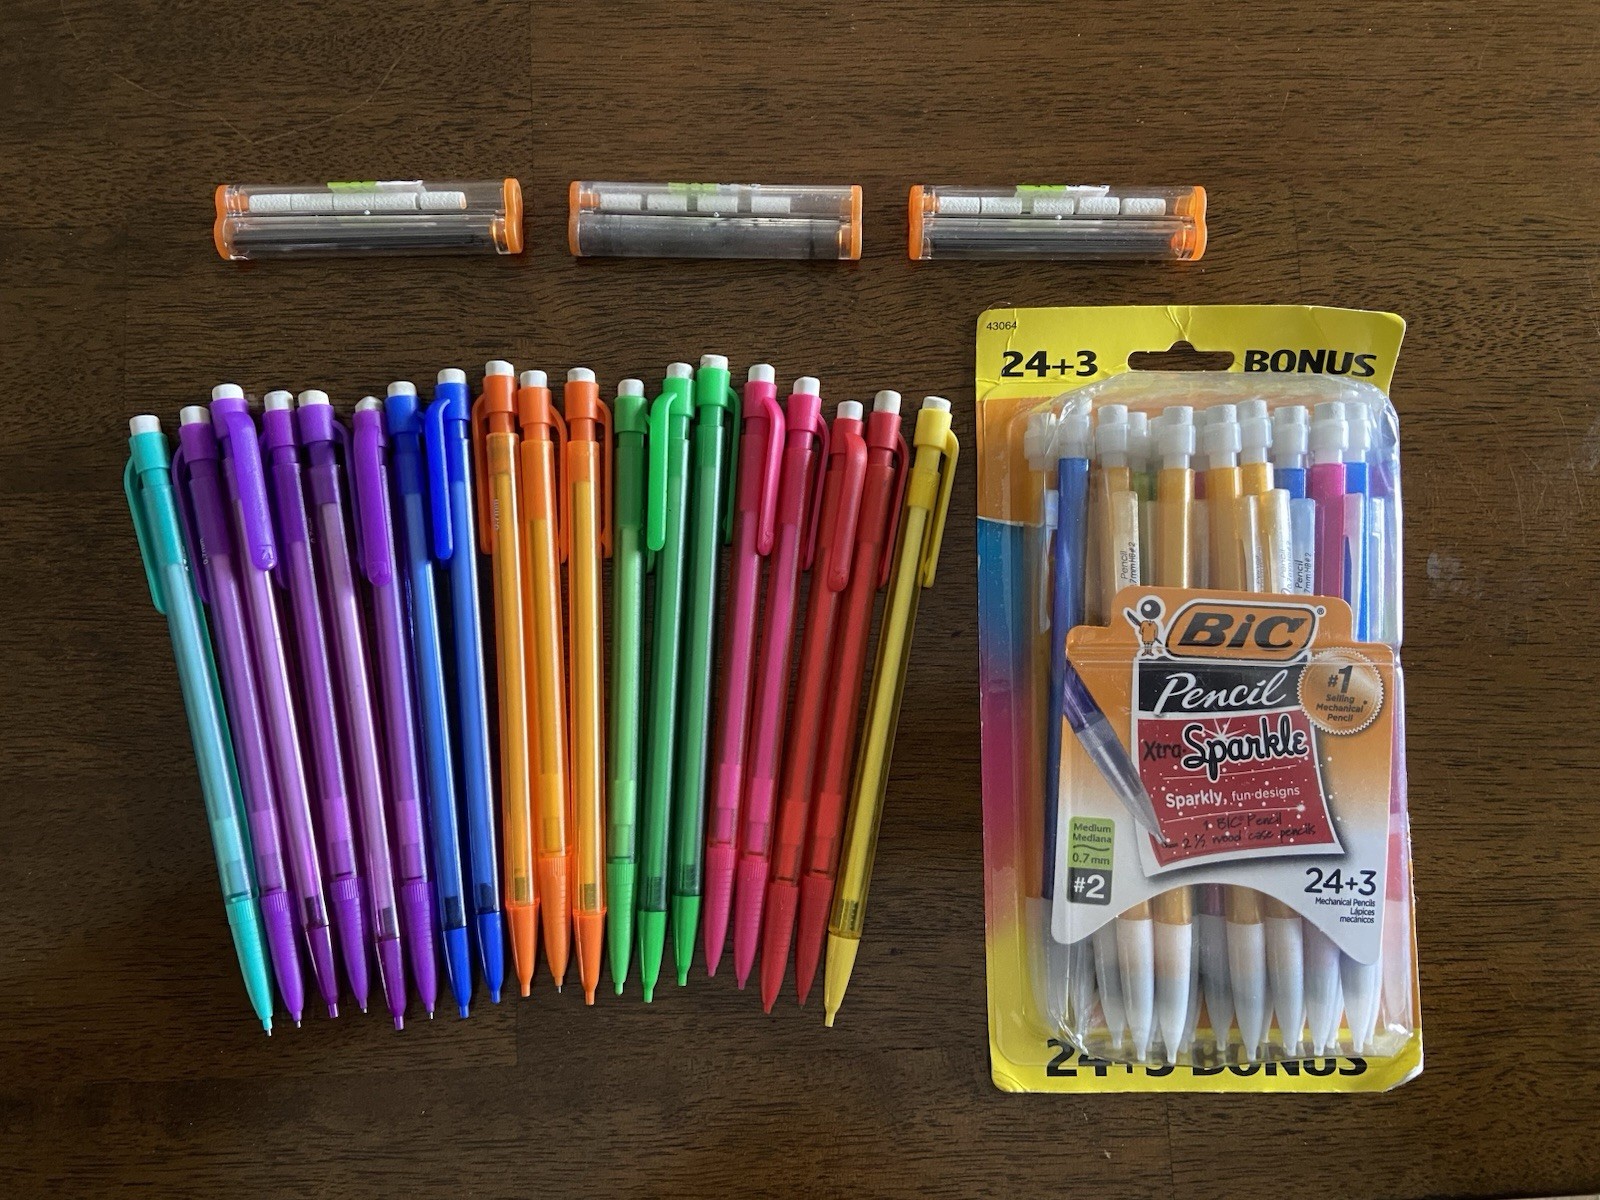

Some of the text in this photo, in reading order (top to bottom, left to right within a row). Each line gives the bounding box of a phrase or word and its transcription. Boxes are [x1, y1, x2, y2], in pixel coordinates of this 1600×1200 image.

[986, 321, 1017, 331] 43064
[1001, 350, 1098, 378] 24+3
[1244, 349, 1377, 377] BONUS
[1120, 550, 1129, 580] Pencil
[1294, 559, 1304, 589] Pencil
[1327, 665, 1354, 694] #1
[1154, 669, 1289, 716] Pencil
[1326, 694, 1355, 704] Selling
[1316, 703, 1364, 713] Mechanical
[1327, 713, 1354, 722] Pencil
[1182, 713, 1309, 782] Sparkle
[1165, 788, 1228, 810] Sparkly,
[1254, 785, 1301, 801] designs
[1073, 823, 1112, 833] Medium
[1247, 811, 1282, 827] Pencil
[1072, 833, 1112, 843] Mediana
[1212, 829, 1242, 843] wood
[1248, 829, 1274, 840] case
[1280, 822, 1315, 843] pencils
[1072, 852, 1110, 865] 0.7 mm
[1073, 874, 1106, 899] #2
[1304, 867, 1377, 896] 24+3
[1315, 897, 1376, 907] Mechanical Pencils
